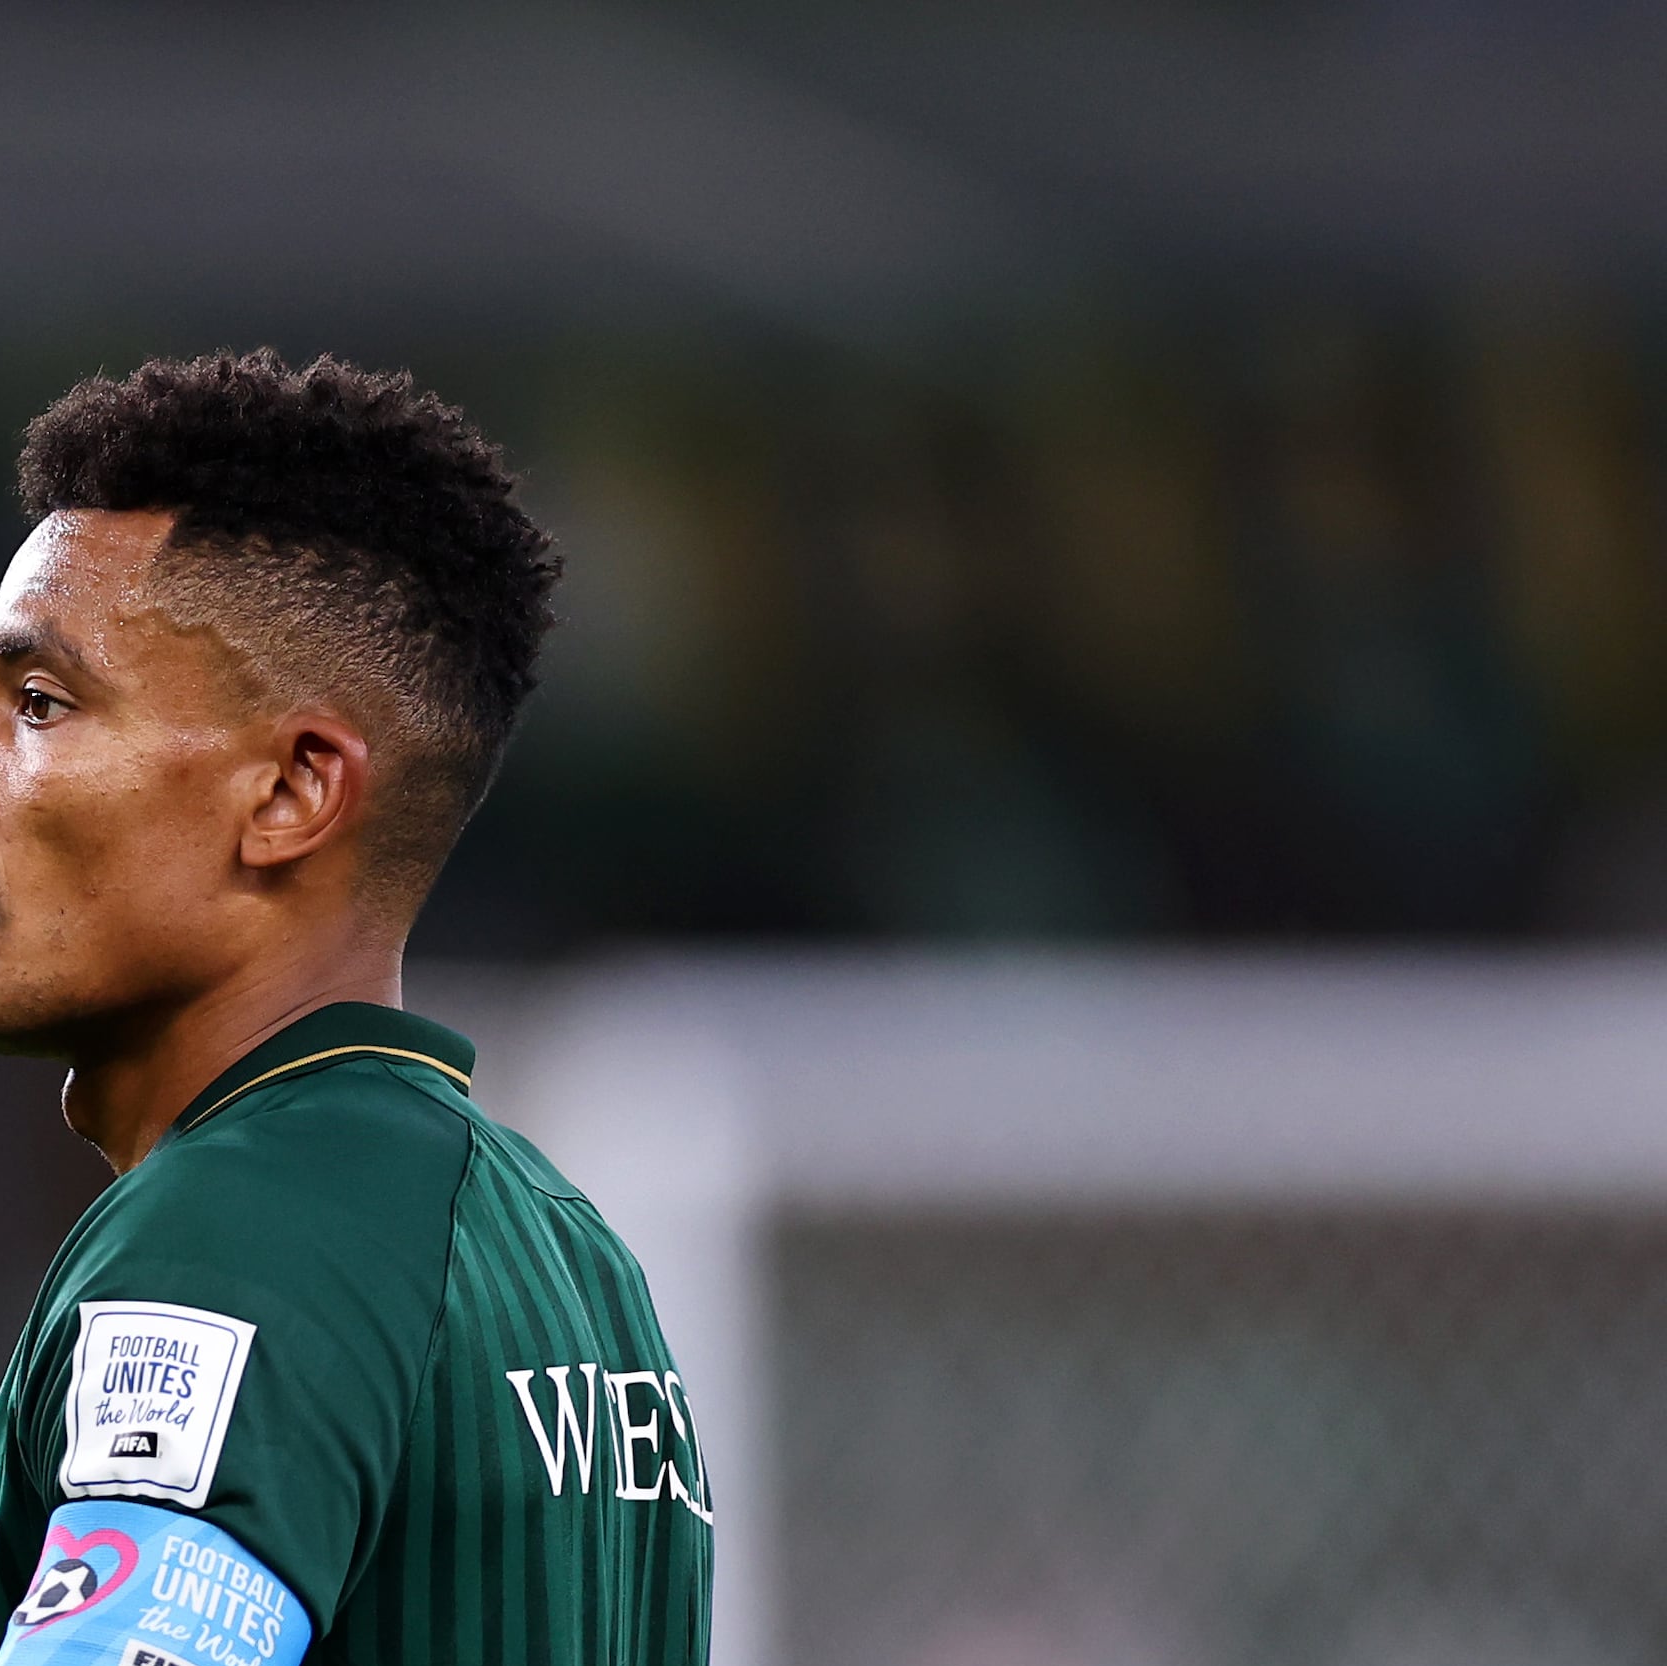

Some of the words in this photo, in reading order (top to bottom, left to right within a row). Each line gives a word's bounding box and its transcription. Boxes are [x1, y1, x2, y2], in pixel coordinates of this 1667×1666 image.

[110, 1336, 200, 1367] FOOTBALL
[102, 1361, 196, 1399] UNITES
[95, 1397, 126, 1427] the
[128, 1399, 195, 1432] World
[114, 1435, 151, 1453] FIFA
[162, 1535, 287, 1621] FOOTBALL
[137, 1605, 192, 1640] the
[151, 1563, 280, 1658] UNITES
